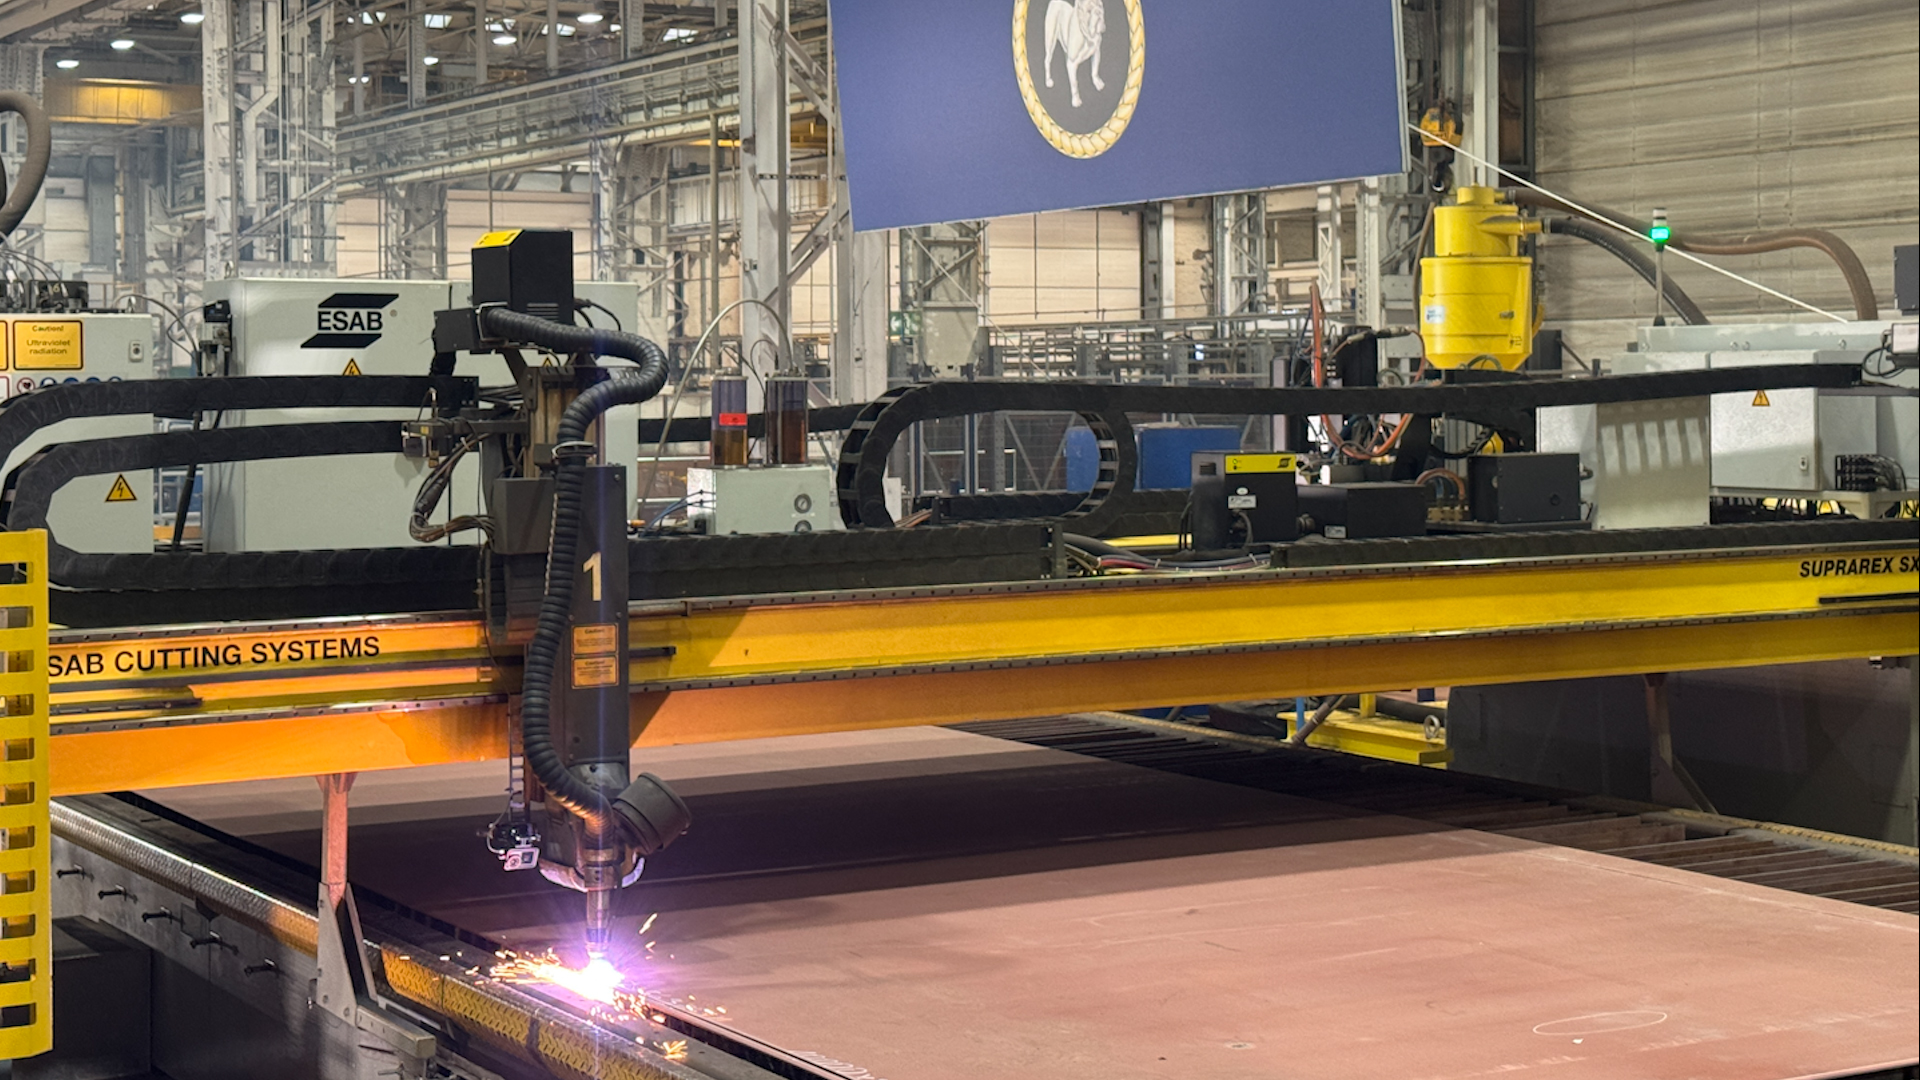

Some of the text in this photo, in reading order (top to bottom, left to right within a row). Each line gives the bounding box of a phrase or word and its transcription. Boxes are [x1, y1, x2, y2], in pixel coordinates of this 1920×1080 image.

[317, 310, 383, 331] ESAB
[26, 339, 71, 347] Ultraviolet
[582, 551, 602, 601] 1
[1800, 556, 1919, 578] SUPRAREX SX
[48, 635, 381, 677] SAB CUTTING SYSTEMS
